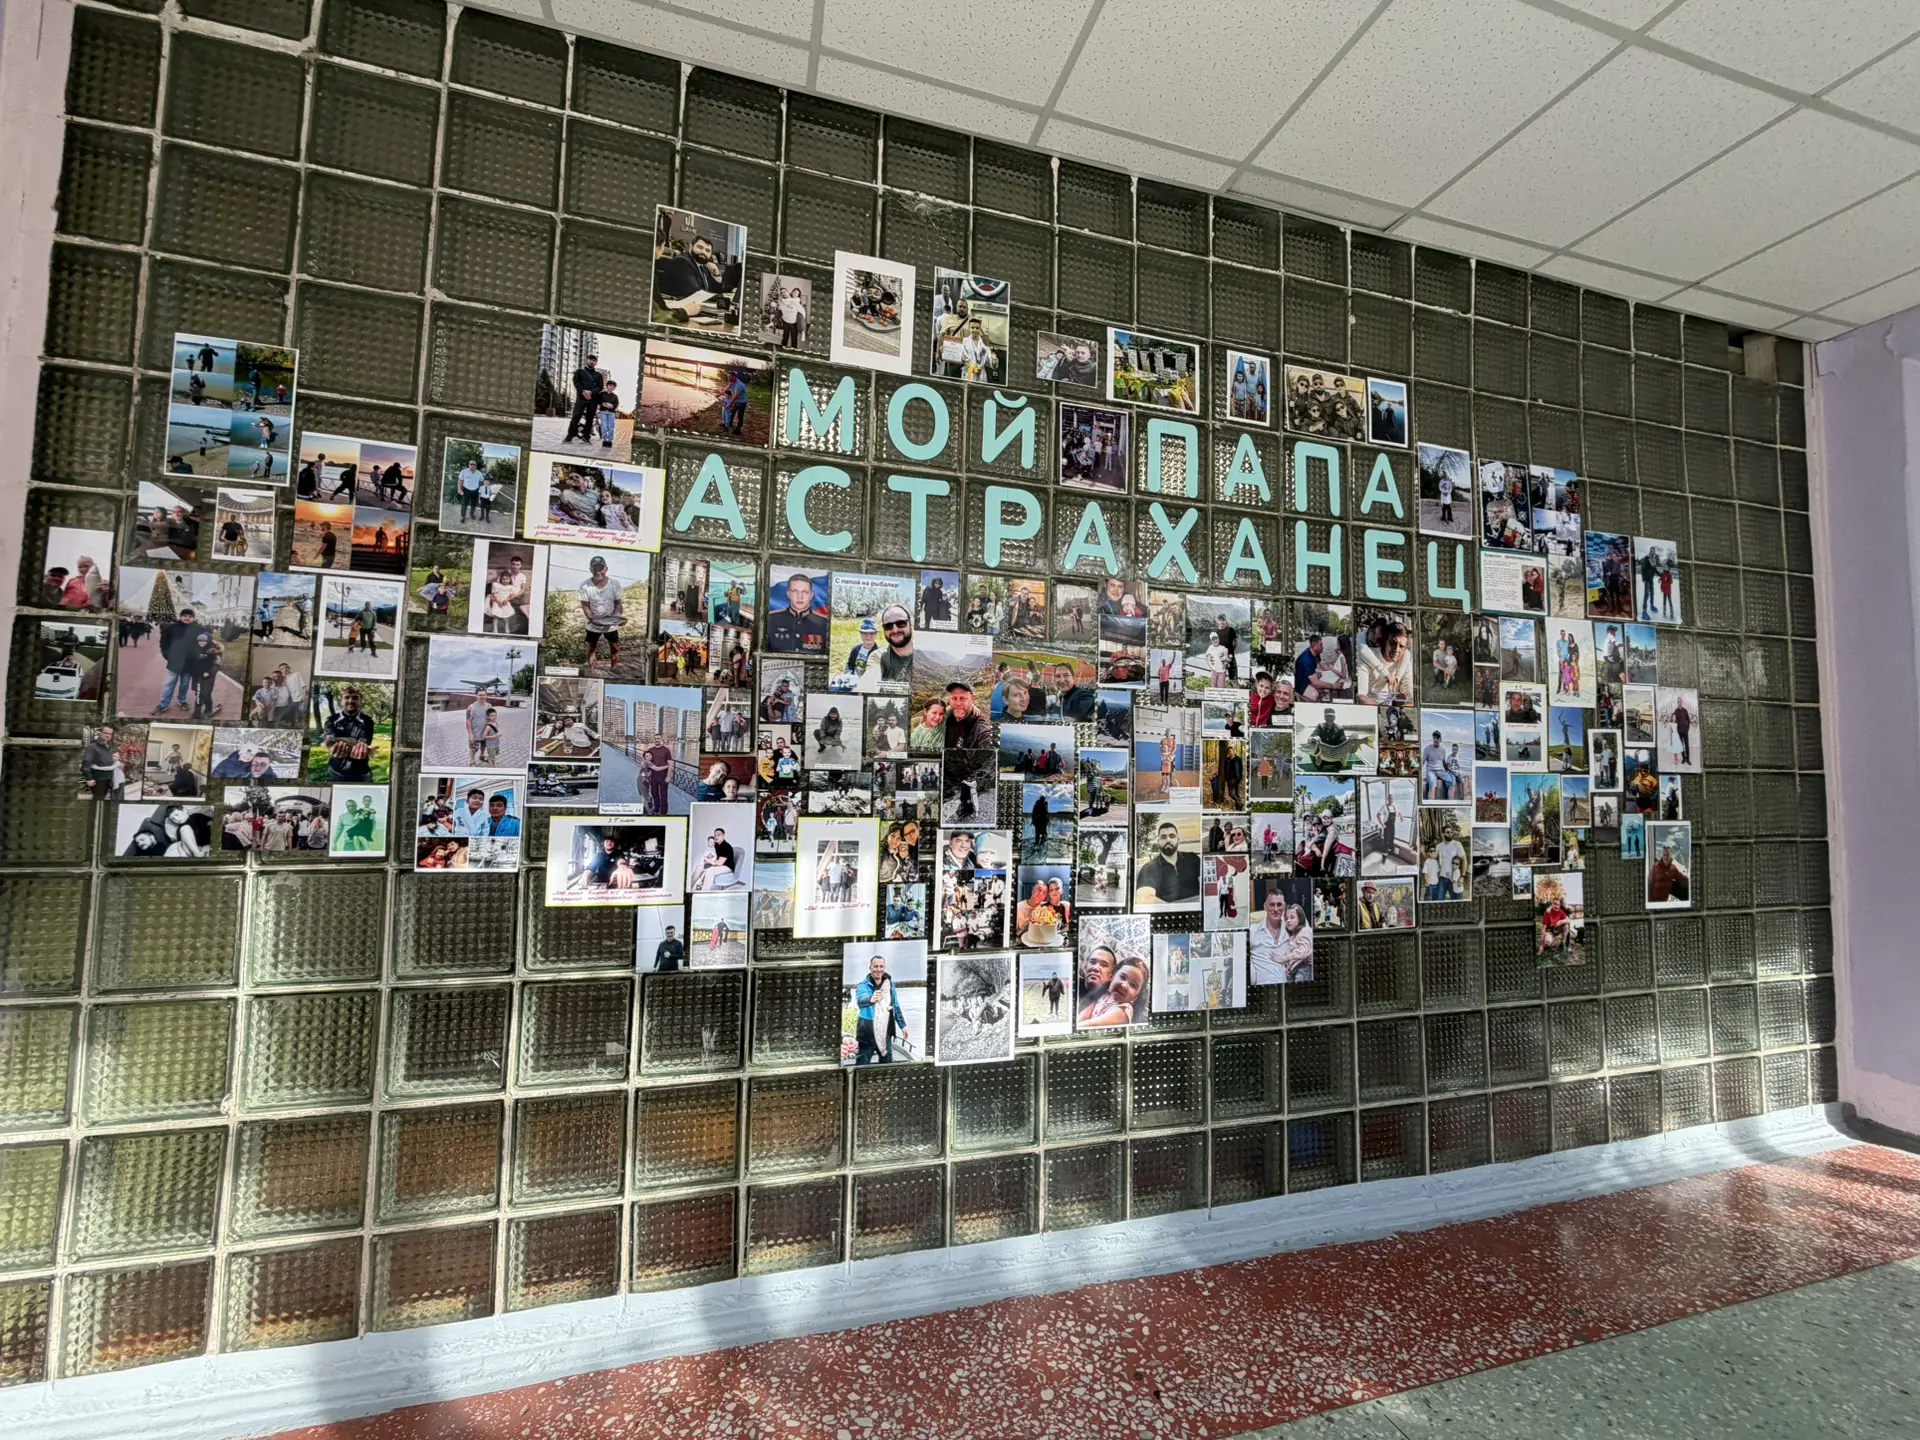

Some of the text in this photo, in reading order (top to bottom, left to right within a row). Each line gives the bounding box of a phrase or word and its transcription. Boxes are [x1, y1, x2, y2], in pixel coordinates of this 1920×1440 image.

[786, 367, 1405, 519] МОЙ ПАПА
[673, 453, 1471, 616] АСТРАХАНЕЦ
[834, 577, 841, 585] С
[840, 577, 861, 587] папой
[861, 580, 871, 588] на
